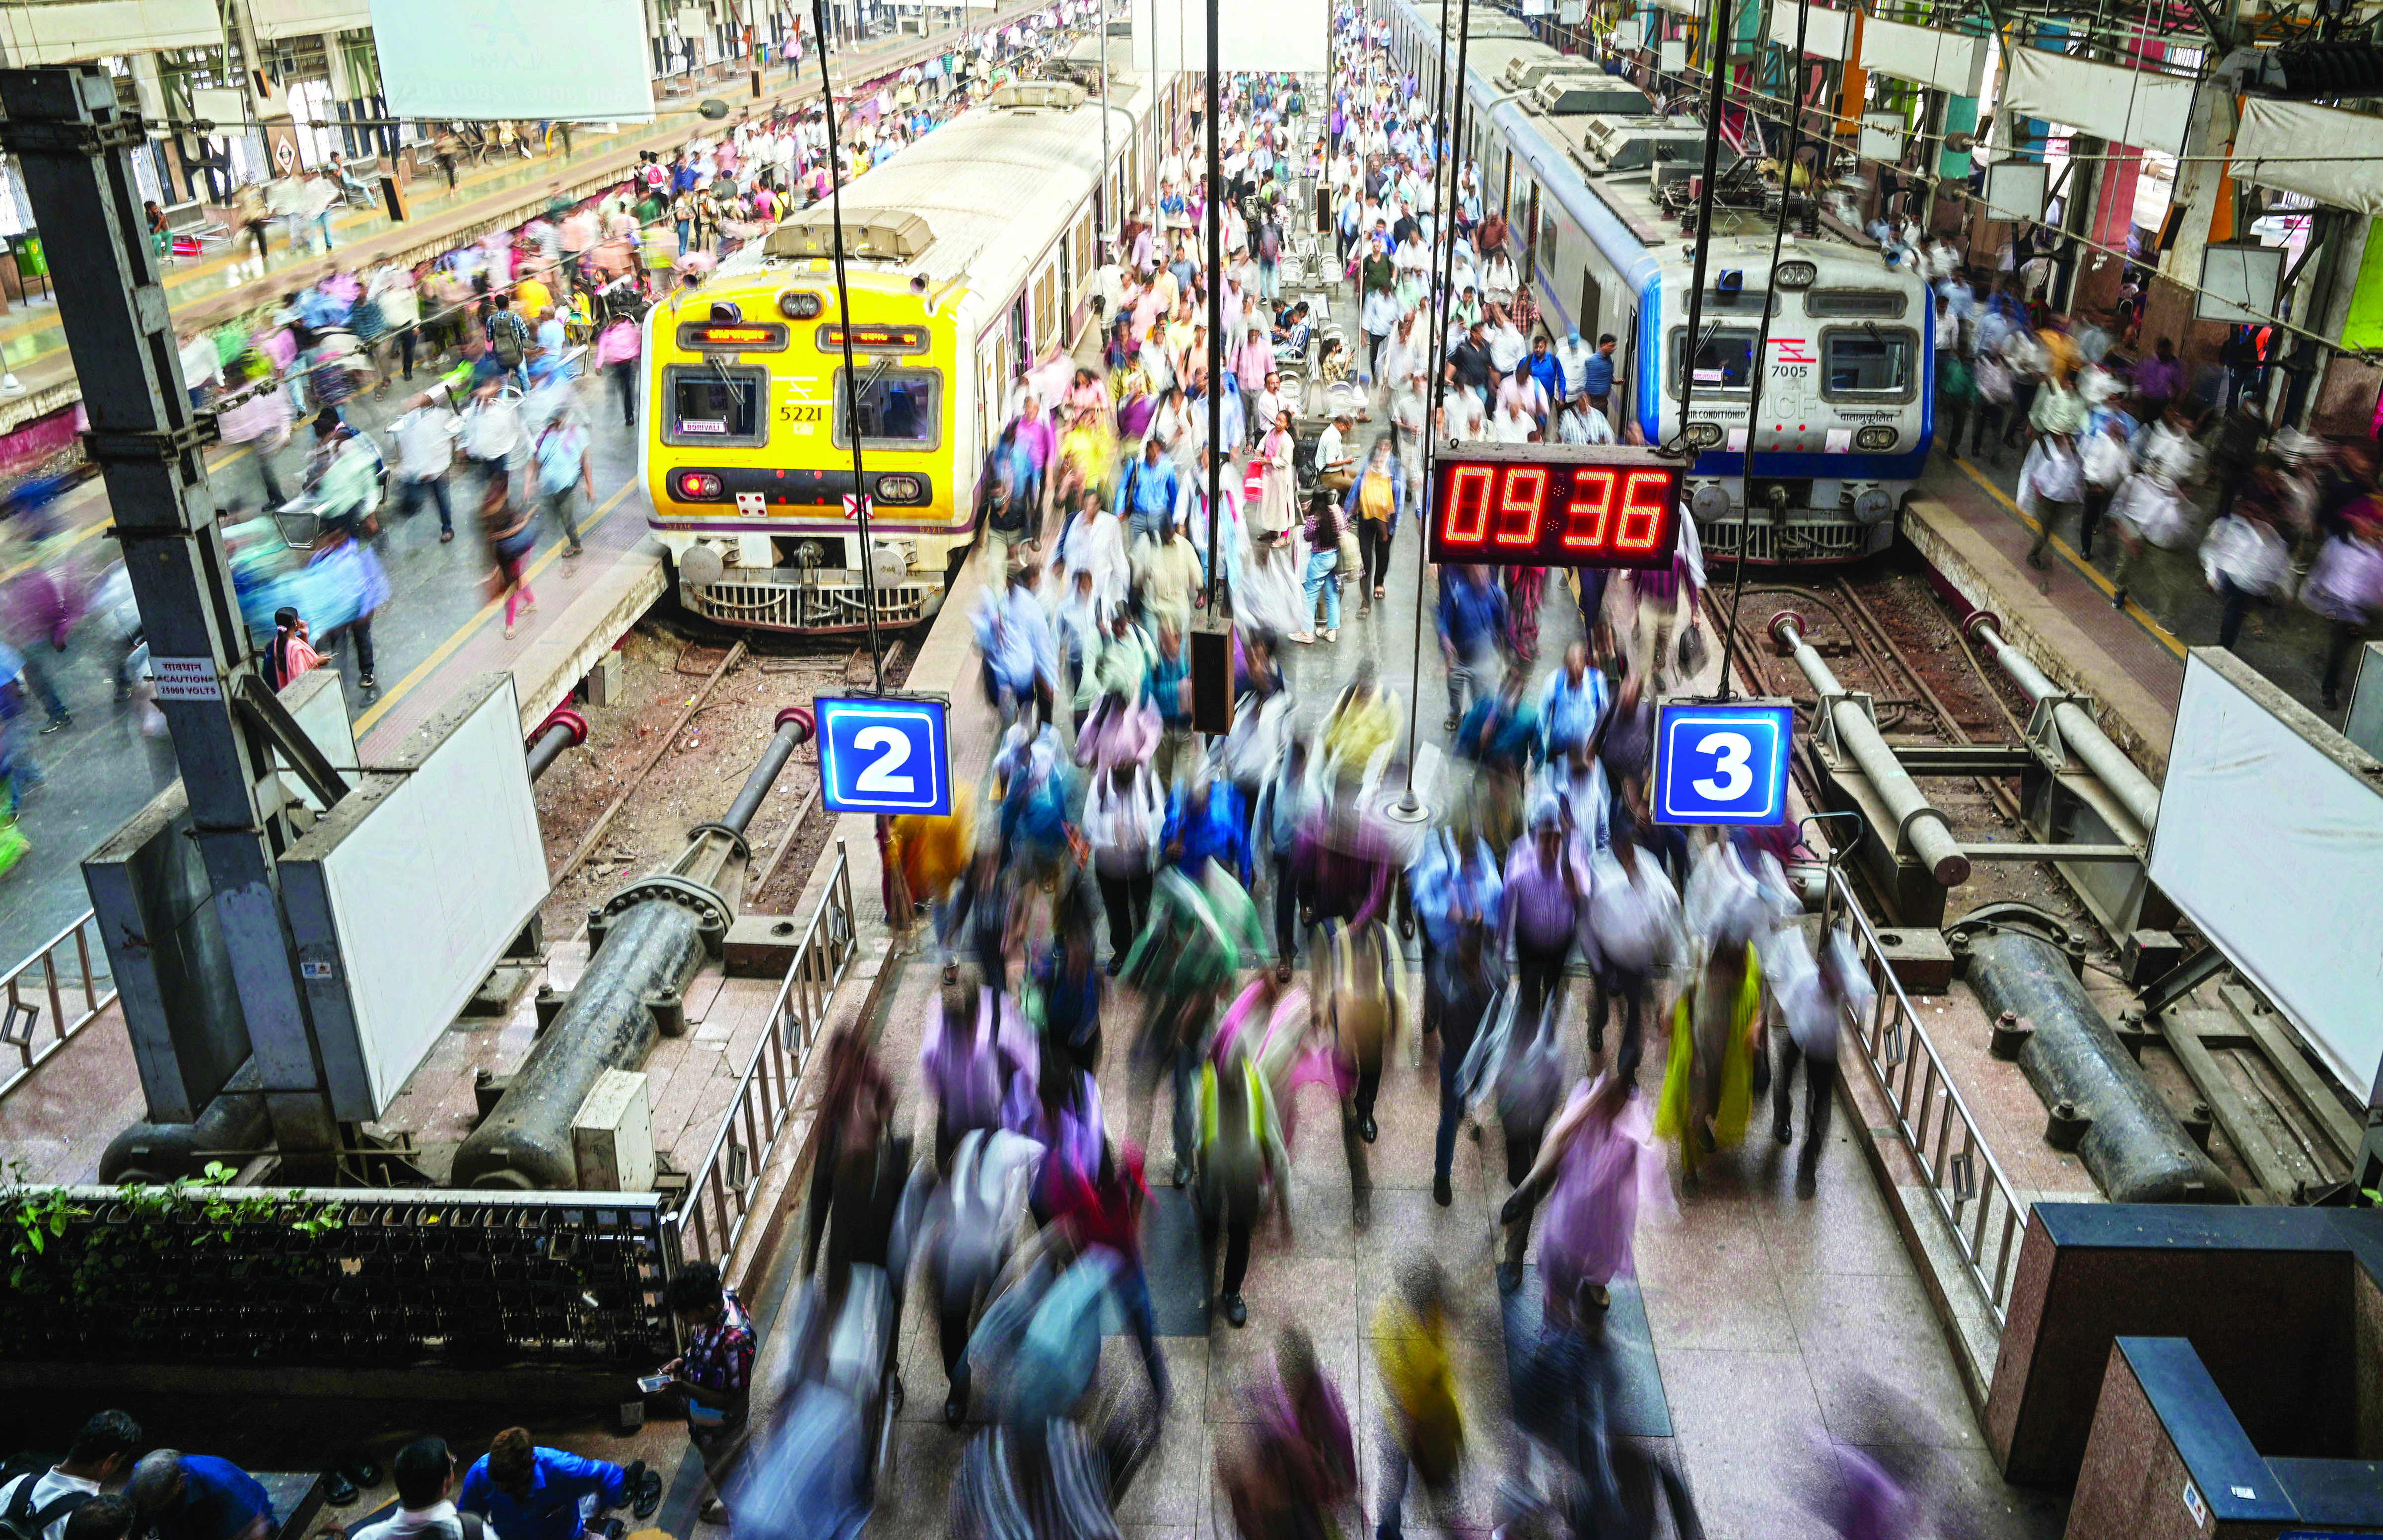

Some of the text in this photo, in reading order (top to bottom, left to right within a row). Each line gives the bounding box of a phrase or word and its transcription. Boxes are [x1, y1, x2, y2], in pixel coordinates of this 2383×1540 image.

[1772, 366, 1807, 378] 7005
[1764, 393, 1818, 420] ICF
[780, 407, 821, 421] 5221
[1699, 410, 1746, 420] CONDITIONED
[1840, 410, 1894, 425] वातानुकूलित
[687, 422, 719, 431] BORIVALI
[162, 662, 202, 672] सावधान
[163, 675, 208, 684] CAUTION
[853, 725, 914, 793] 2
[1692, 732, 1753, 801] 3
